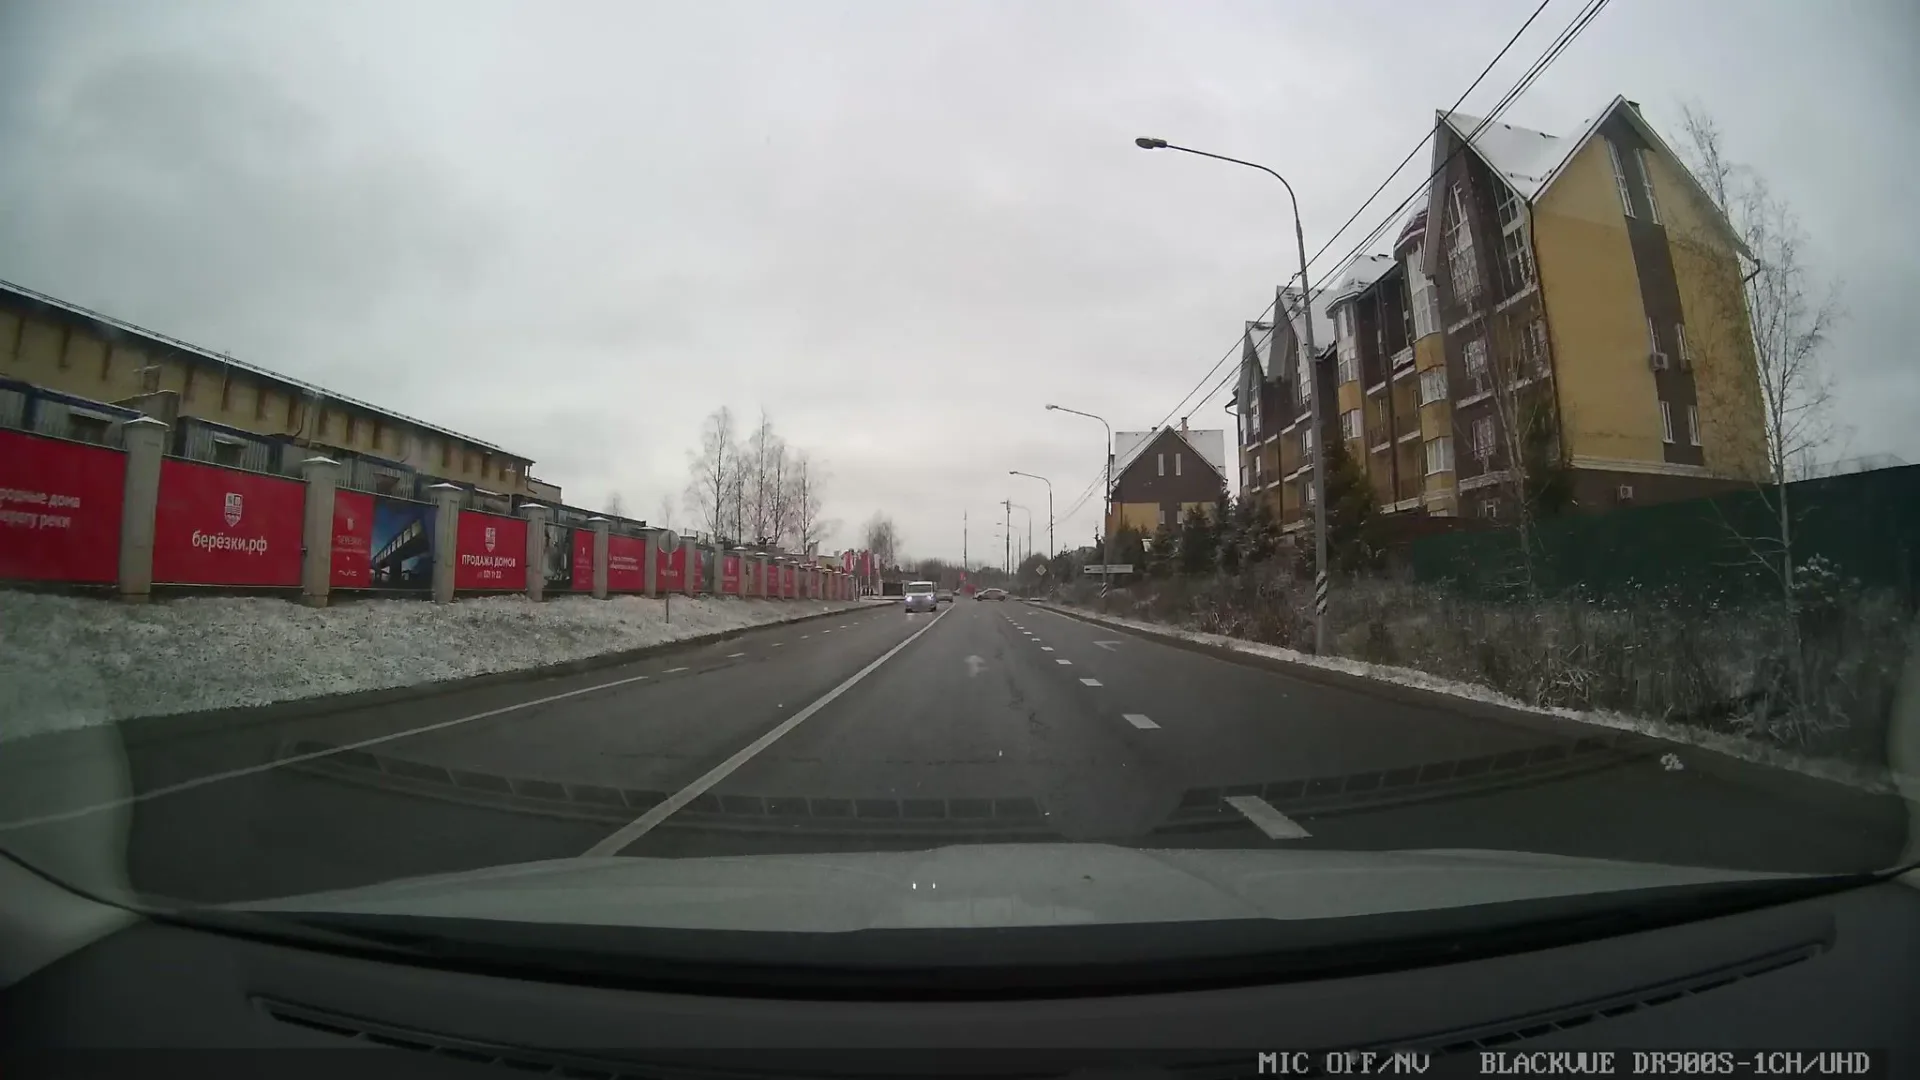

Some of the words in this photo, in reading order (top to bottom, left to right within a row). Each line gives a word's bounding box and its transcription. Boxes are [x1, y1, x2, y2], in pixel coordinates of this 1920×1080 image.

[48, 494, 80, 508] дома
[192, 530, 267, 555] берёзки.рф
[461, 554, 493, 567] ПРОДАЖА
[494, 556, 516, 568] ДОМОВ
